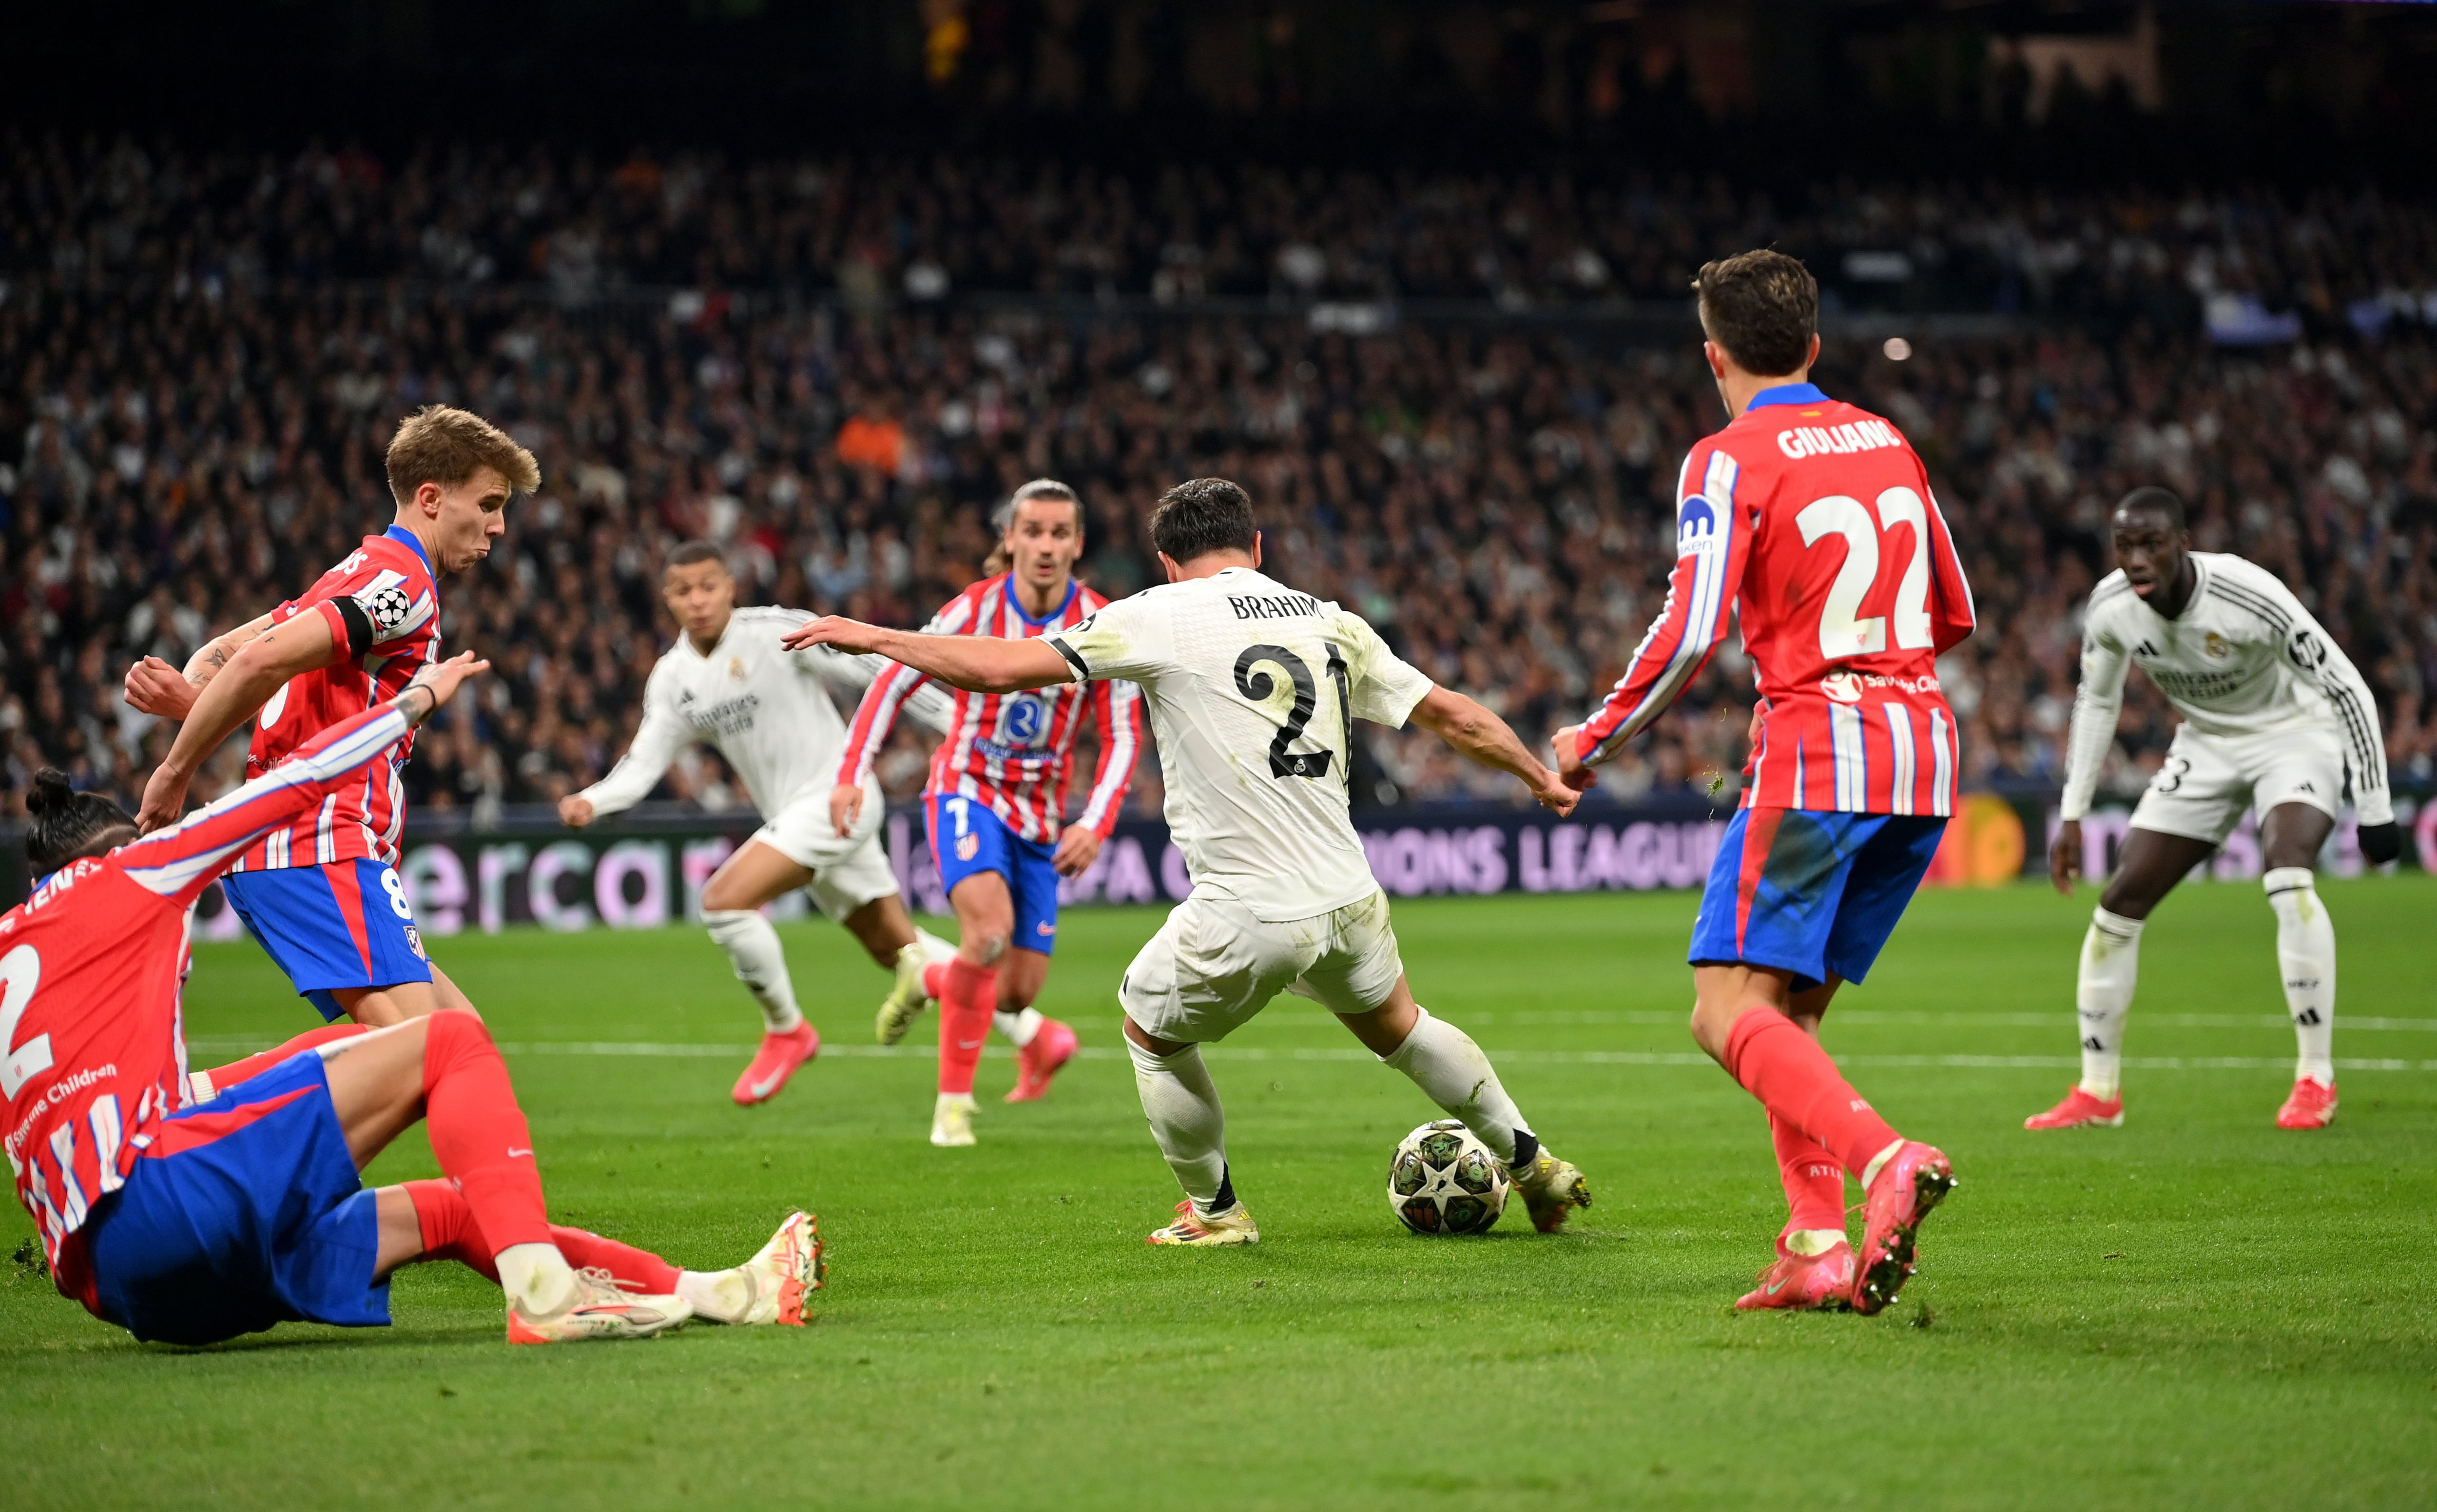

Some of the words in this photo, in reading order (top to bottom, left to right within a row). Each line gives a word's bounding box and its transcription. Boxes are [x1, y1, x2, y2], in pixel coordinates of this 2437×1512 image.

[1227, 595, 1325, 620] BRAHIM
[1795, 486, 1934, 660] 22
[1234, 642, 1352, 786] 21
[380, 867, 412, 920] 8
[0, 944, 54, 1103] 2
[47, 1063, 118, 1104] Children
